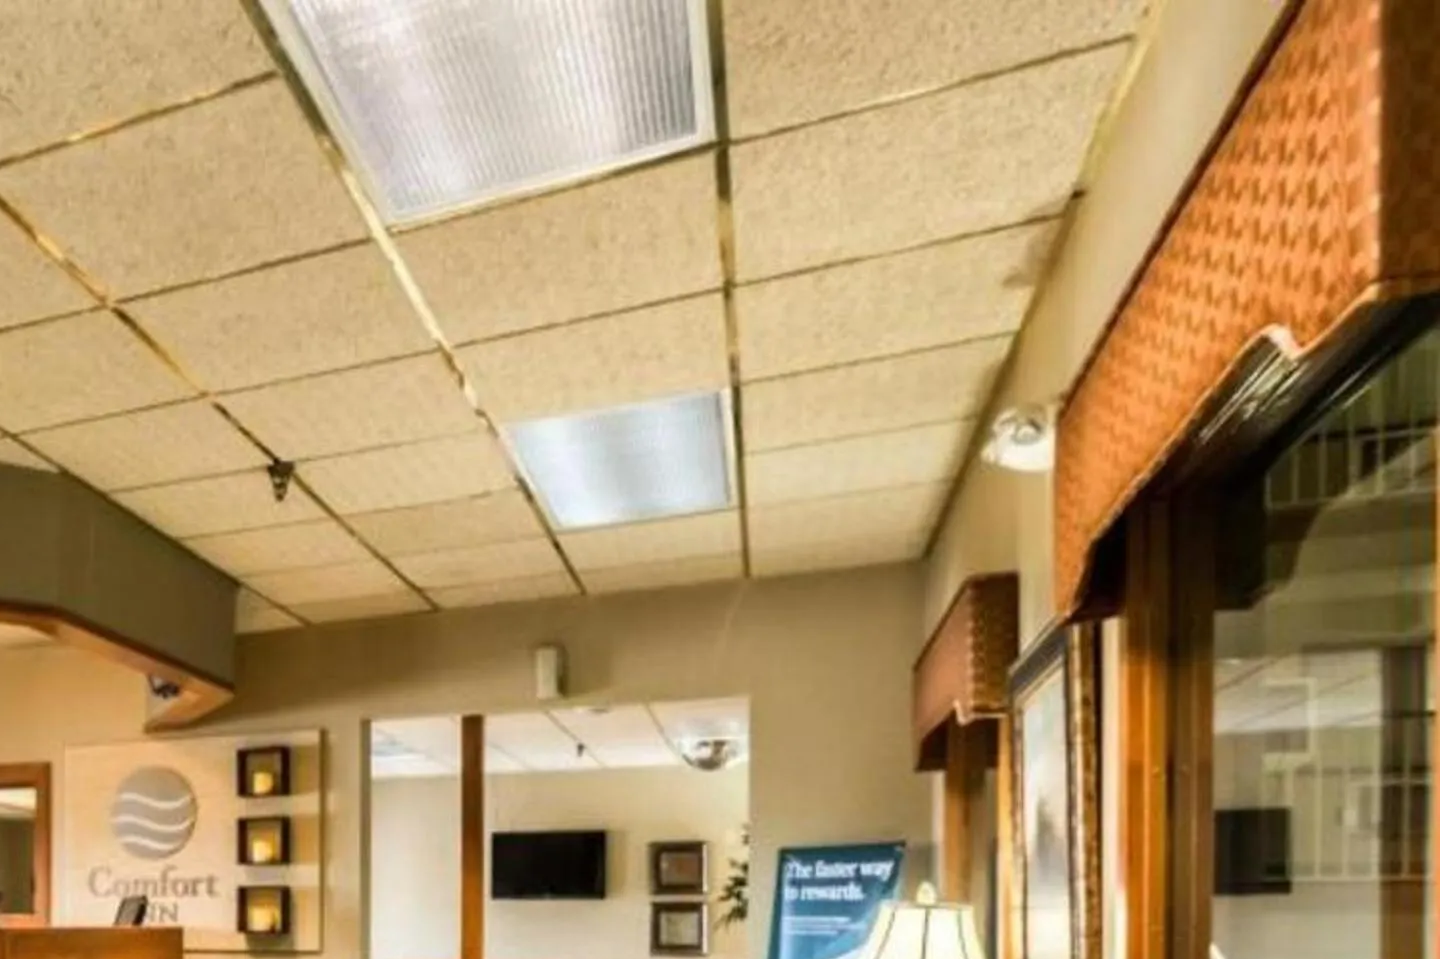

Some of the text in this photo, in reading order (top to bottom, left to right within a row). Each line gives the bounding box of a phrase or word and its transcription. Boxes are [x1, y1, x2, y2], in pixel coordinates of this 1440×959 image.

[88, 865, 218, 898] Comfort
[785, 860, 813, 879] The
[860, 861, 894, 882] way
